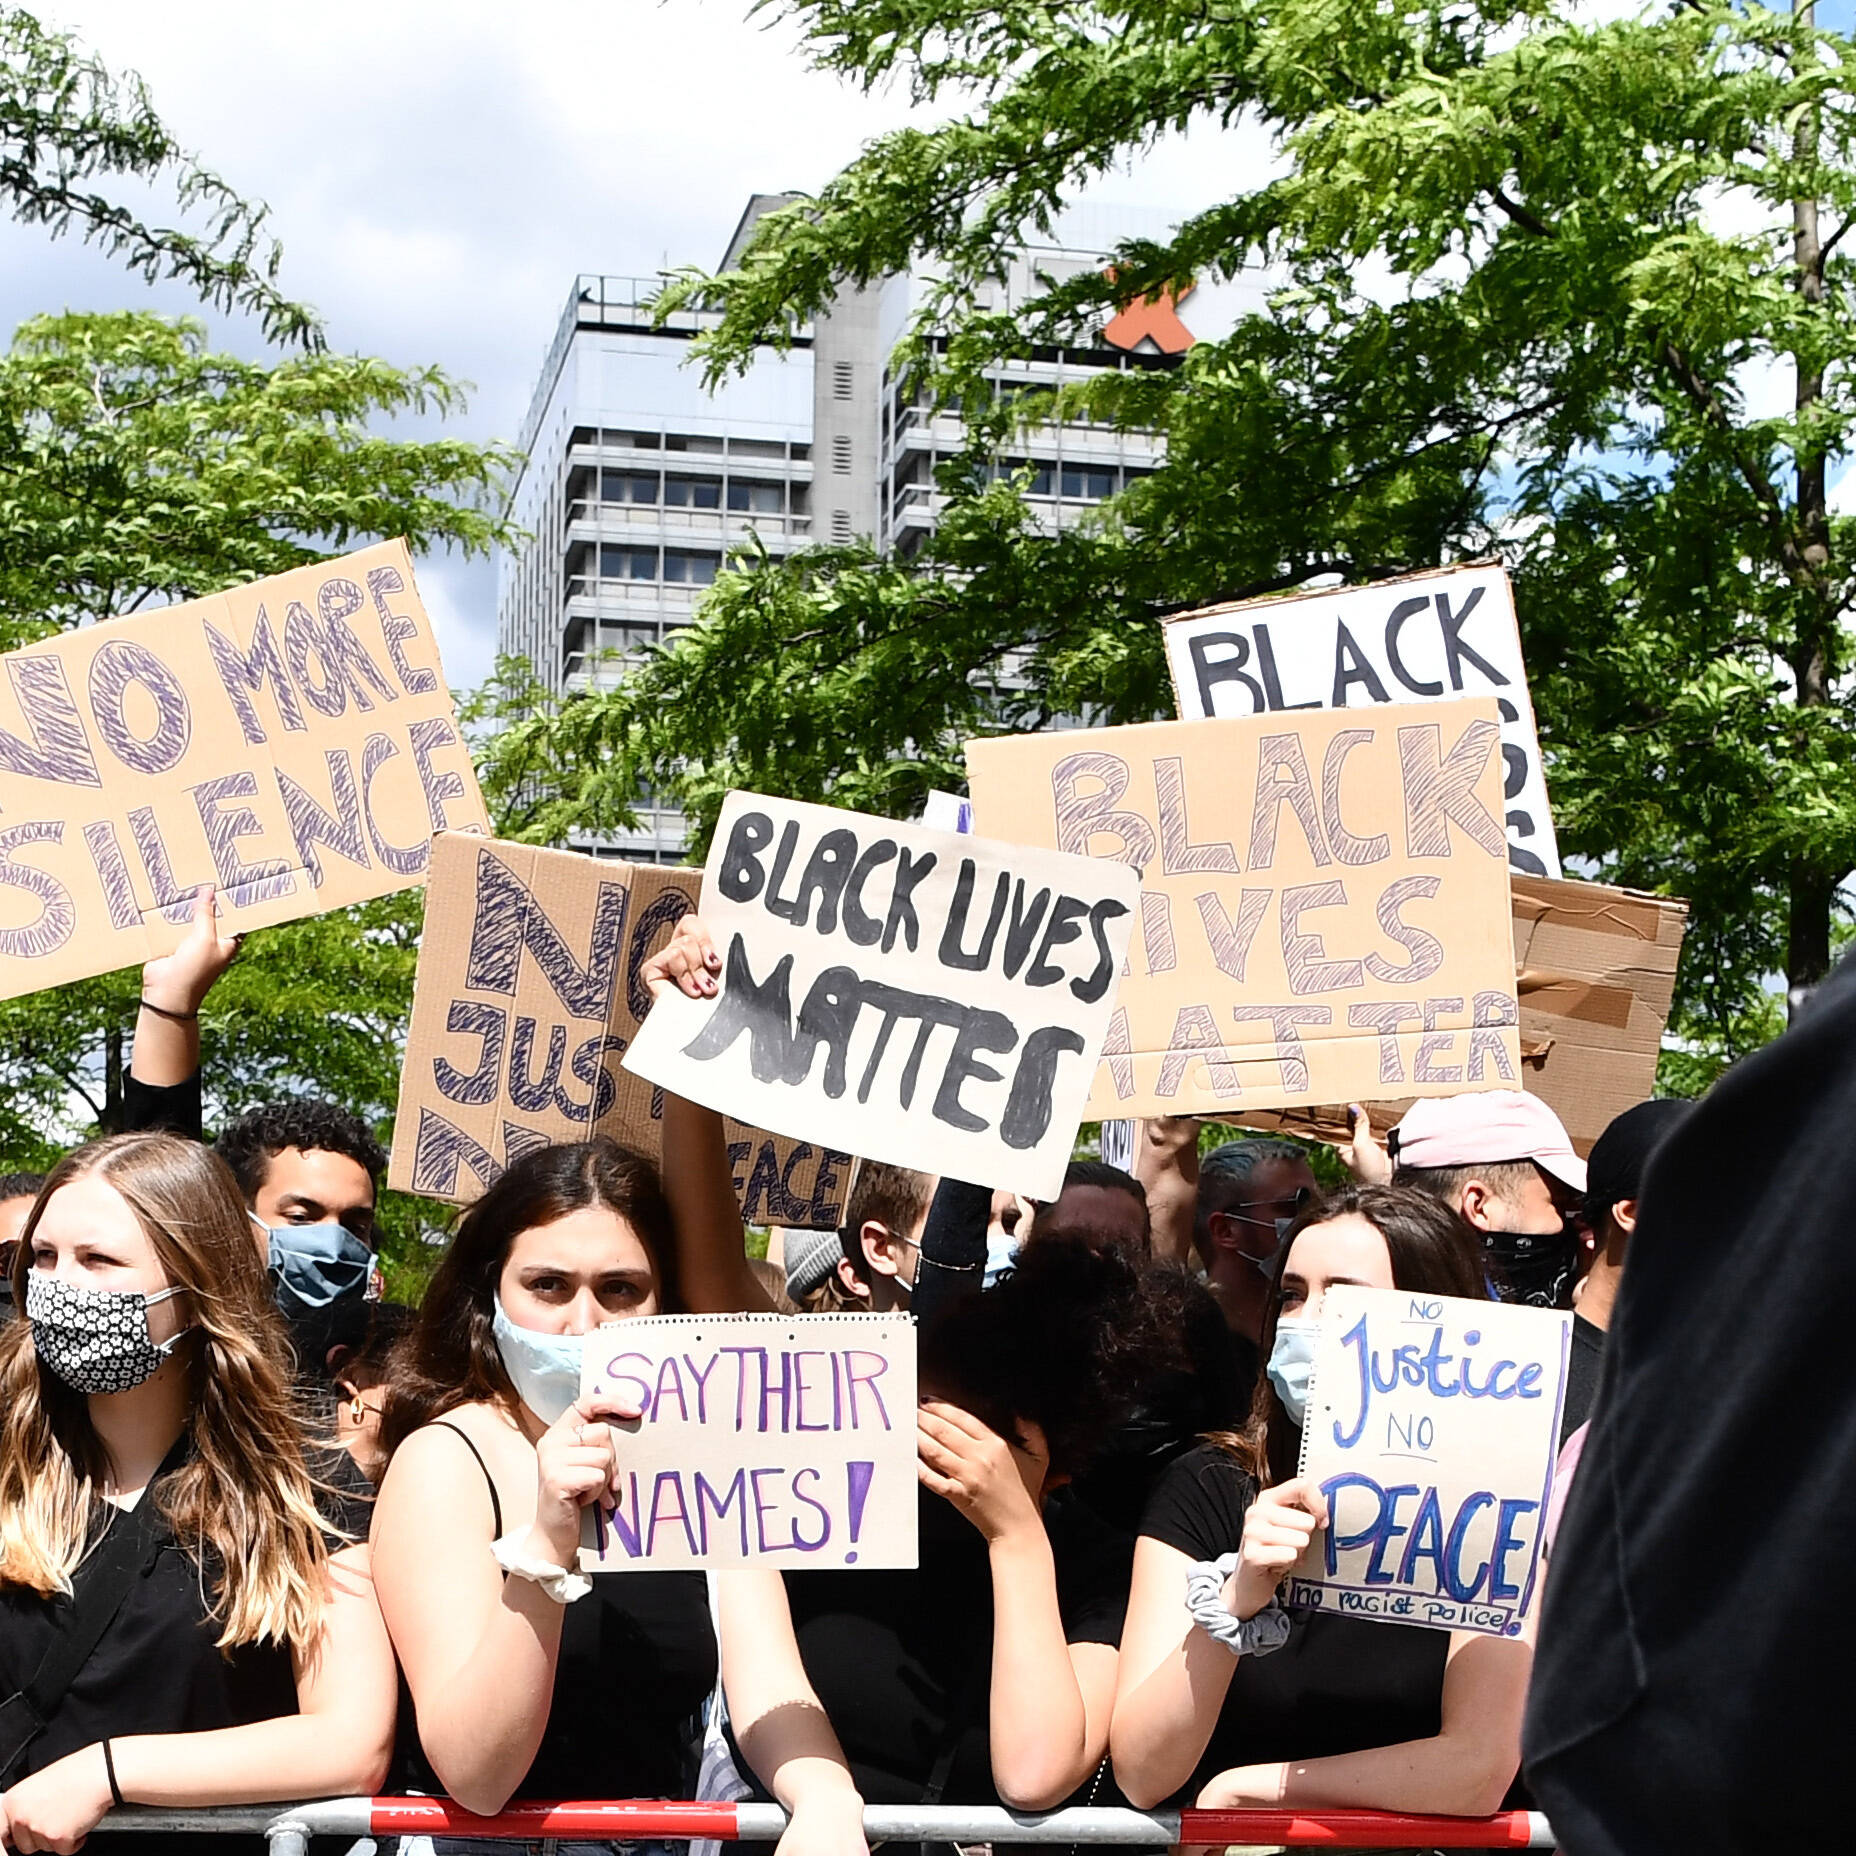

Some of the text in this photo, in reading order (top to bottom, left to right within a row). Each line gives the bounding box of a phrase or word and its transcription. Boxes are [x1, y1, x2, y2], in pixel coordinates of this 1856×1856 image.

[203, 566, 437, 746] MORE
[1188, 586, 1511, 717] BLACK
[1052, 720, 1505, 876] BLACK
[718, 812, 1131, 1004] BLACK LIVES
[1122, 876, 1444, 995] IVES
[1409, 1299, 1443, 1320] NO
[1332, 1312, 1544, 1449] Justice
[1387, 1412, 1433, 1450] NO
[1339, 1592, 1415, 1615] racist
